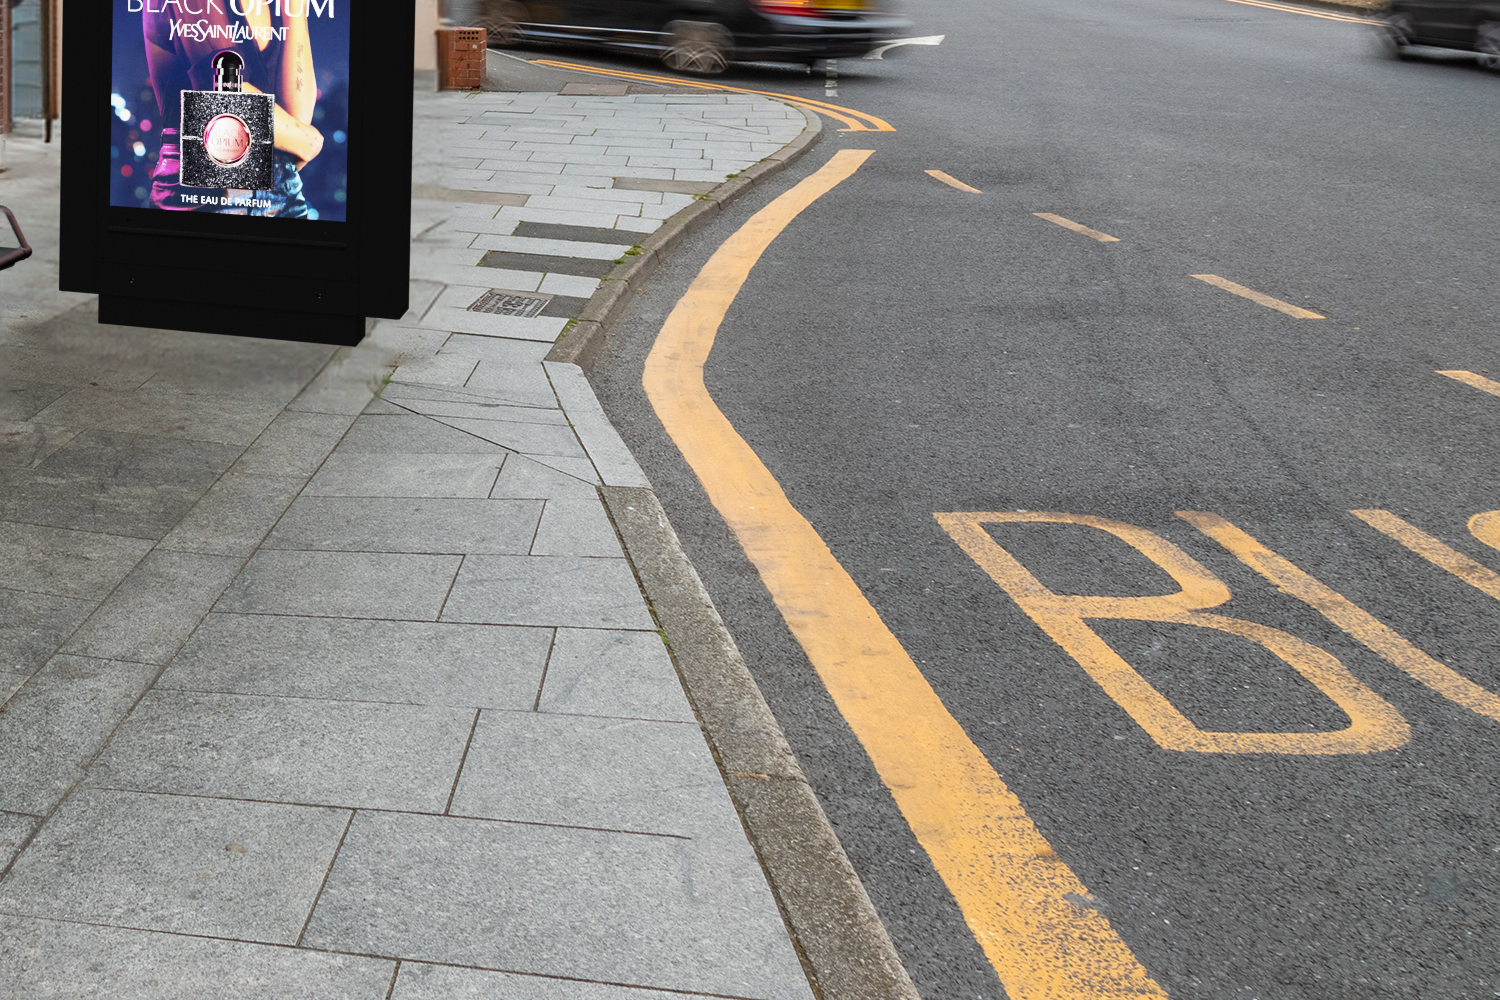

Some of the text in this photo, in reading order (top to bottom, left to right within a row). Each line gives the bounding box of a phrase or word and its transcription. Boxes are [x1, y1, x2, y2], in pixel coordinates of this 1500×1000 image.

[212, 138, 244, 148] OPIUM
[180, 194, 272, 208] THE EAU DE PARFUM
